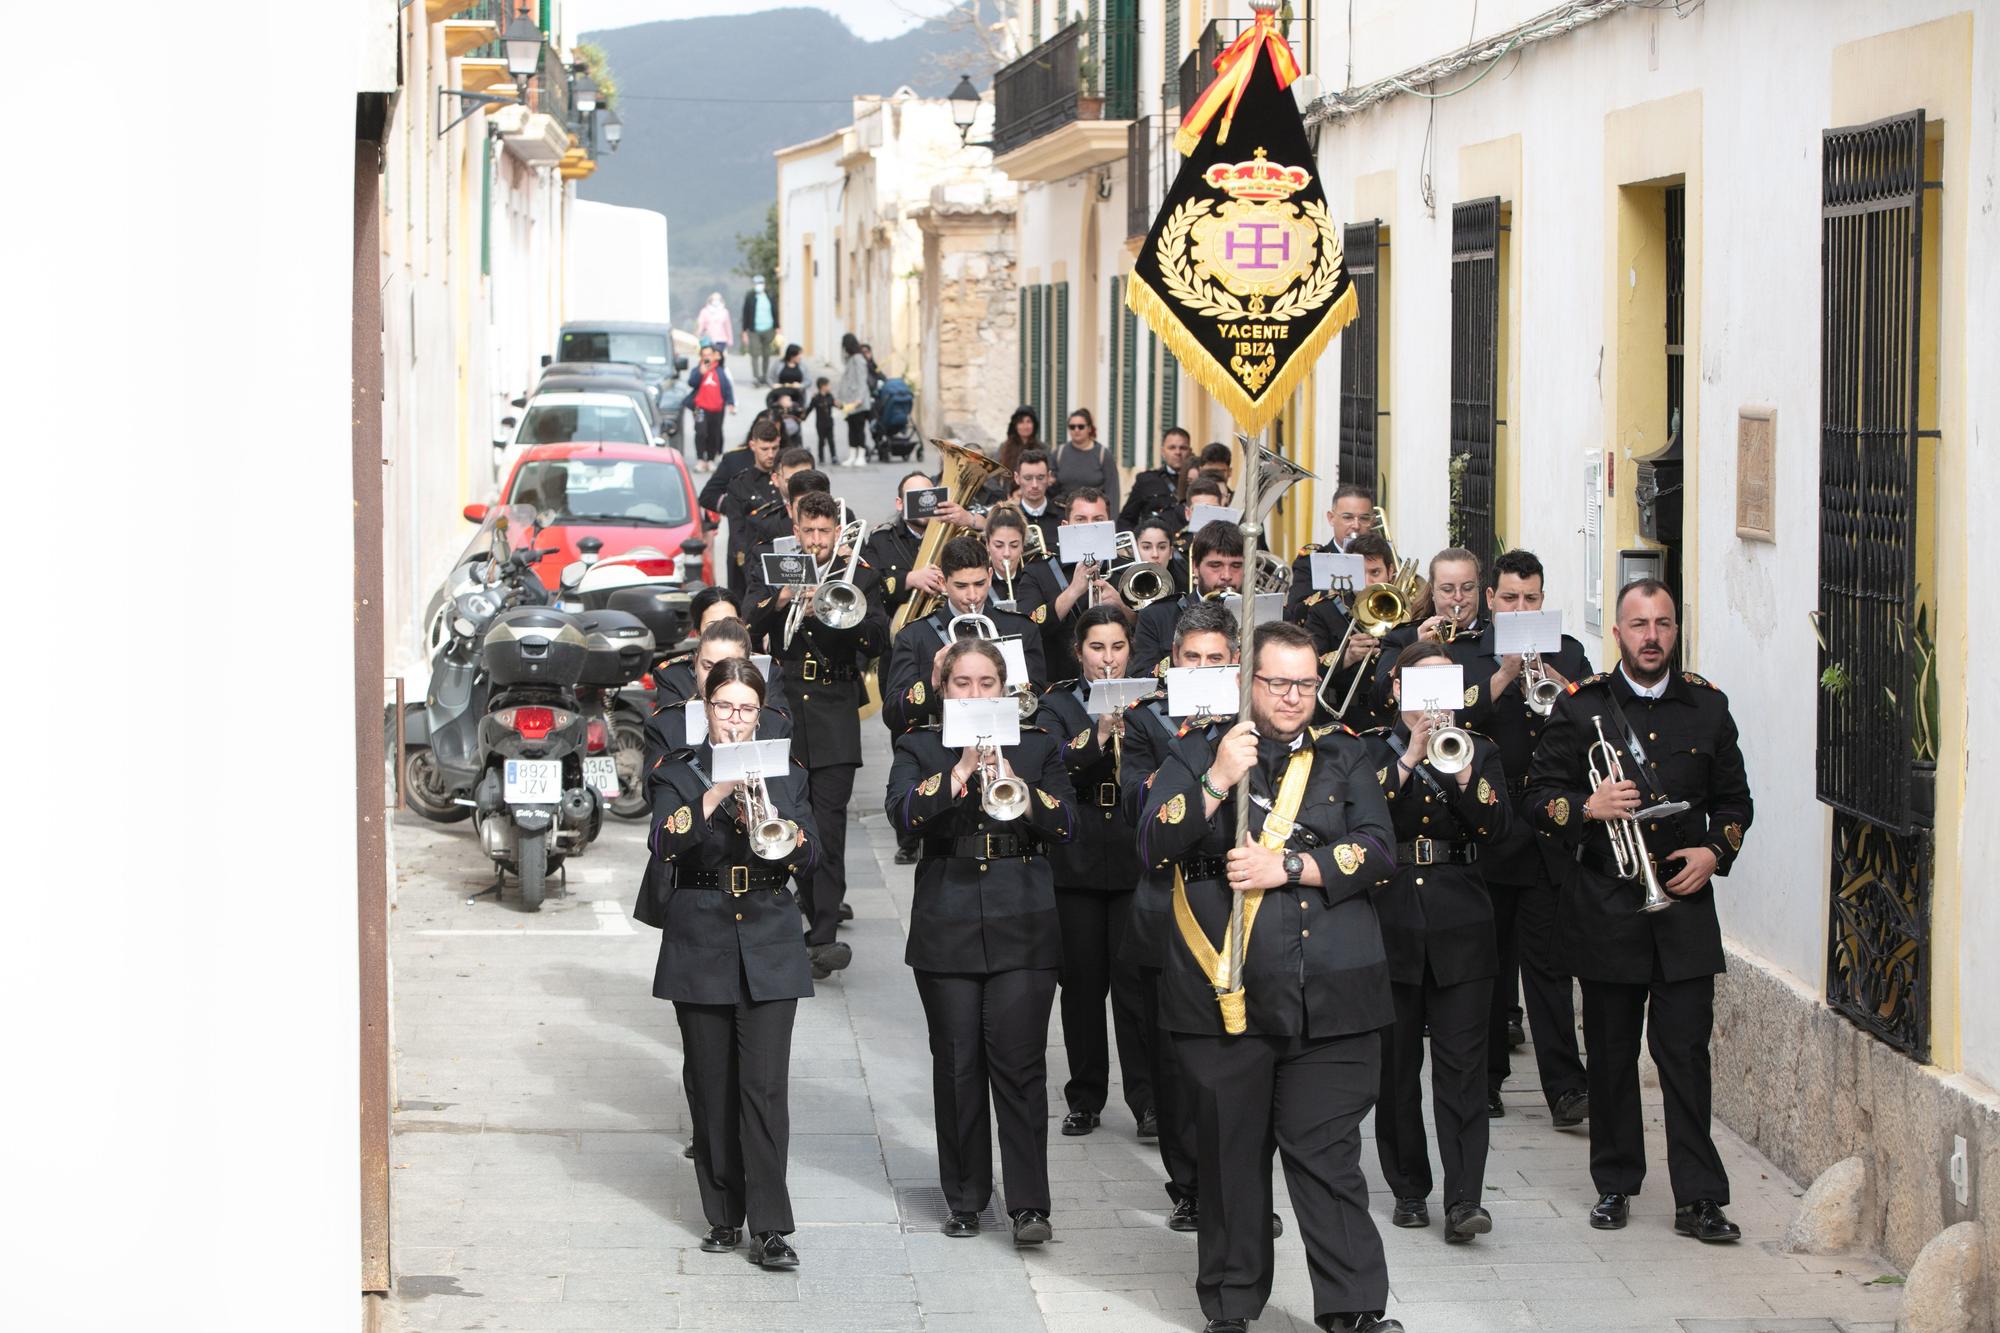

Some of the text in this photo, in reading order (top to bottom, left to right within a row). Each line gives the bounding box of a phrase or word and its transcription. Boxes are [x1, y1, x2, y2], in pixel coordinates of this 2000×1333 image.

[1217, 323, 1290, 339] YACENTE
[1235, 341, 1275, 356] IBIZA
[519, 763, 558, 779] 8921
[519, 780, 548, 794] JZV
